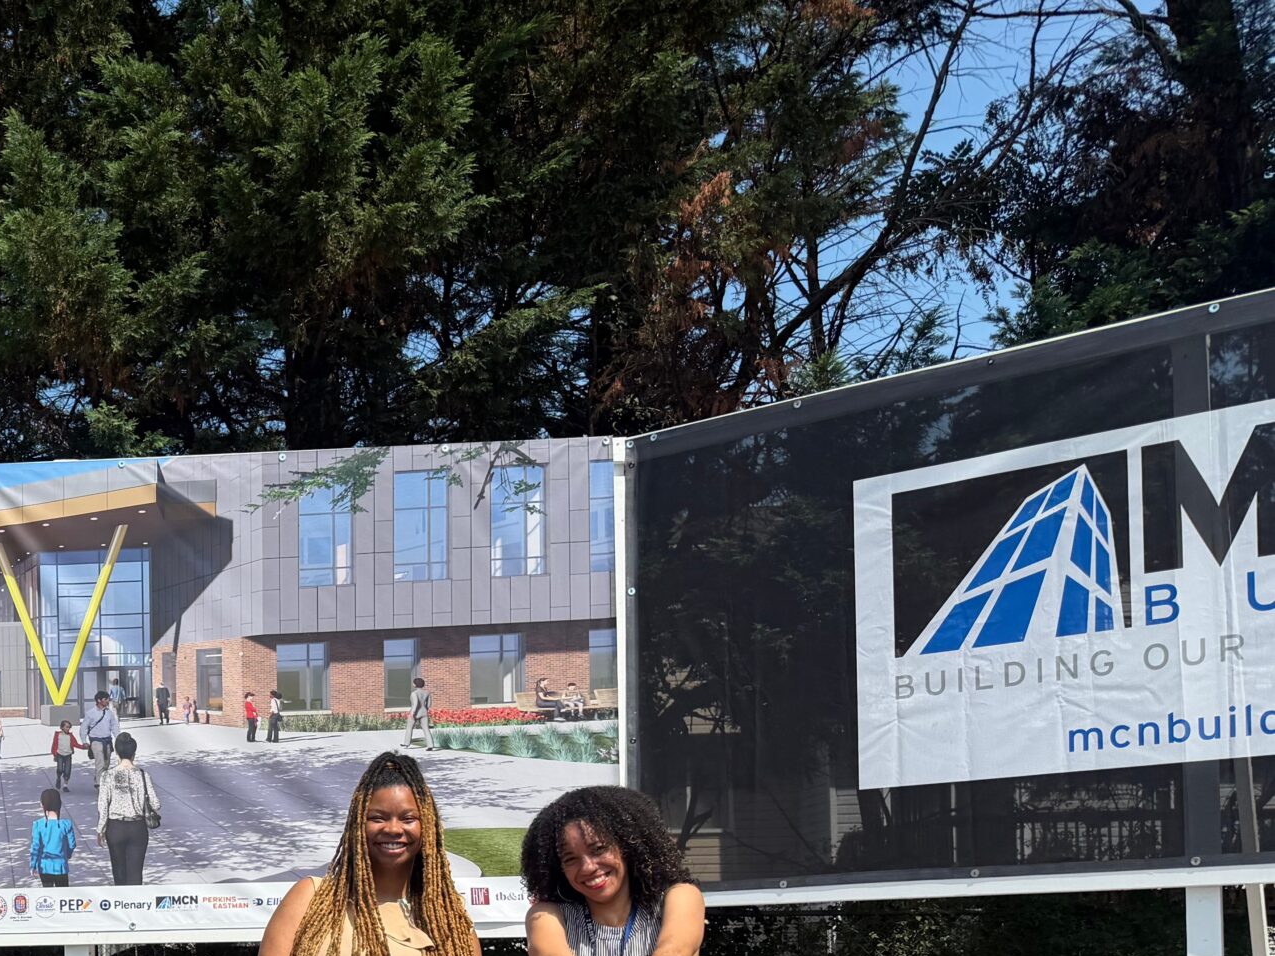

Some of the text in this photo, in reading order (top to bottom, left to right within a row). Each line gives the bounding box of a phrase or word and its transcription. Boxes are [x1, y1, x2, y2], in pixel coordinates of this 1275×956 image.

[895, 633, 1245, 700] BUILDING OUR
[60, 899, 84, 911] PEP
[114, 900, 152, 910] Plenary
[172, 896, 198, 905] MCN
